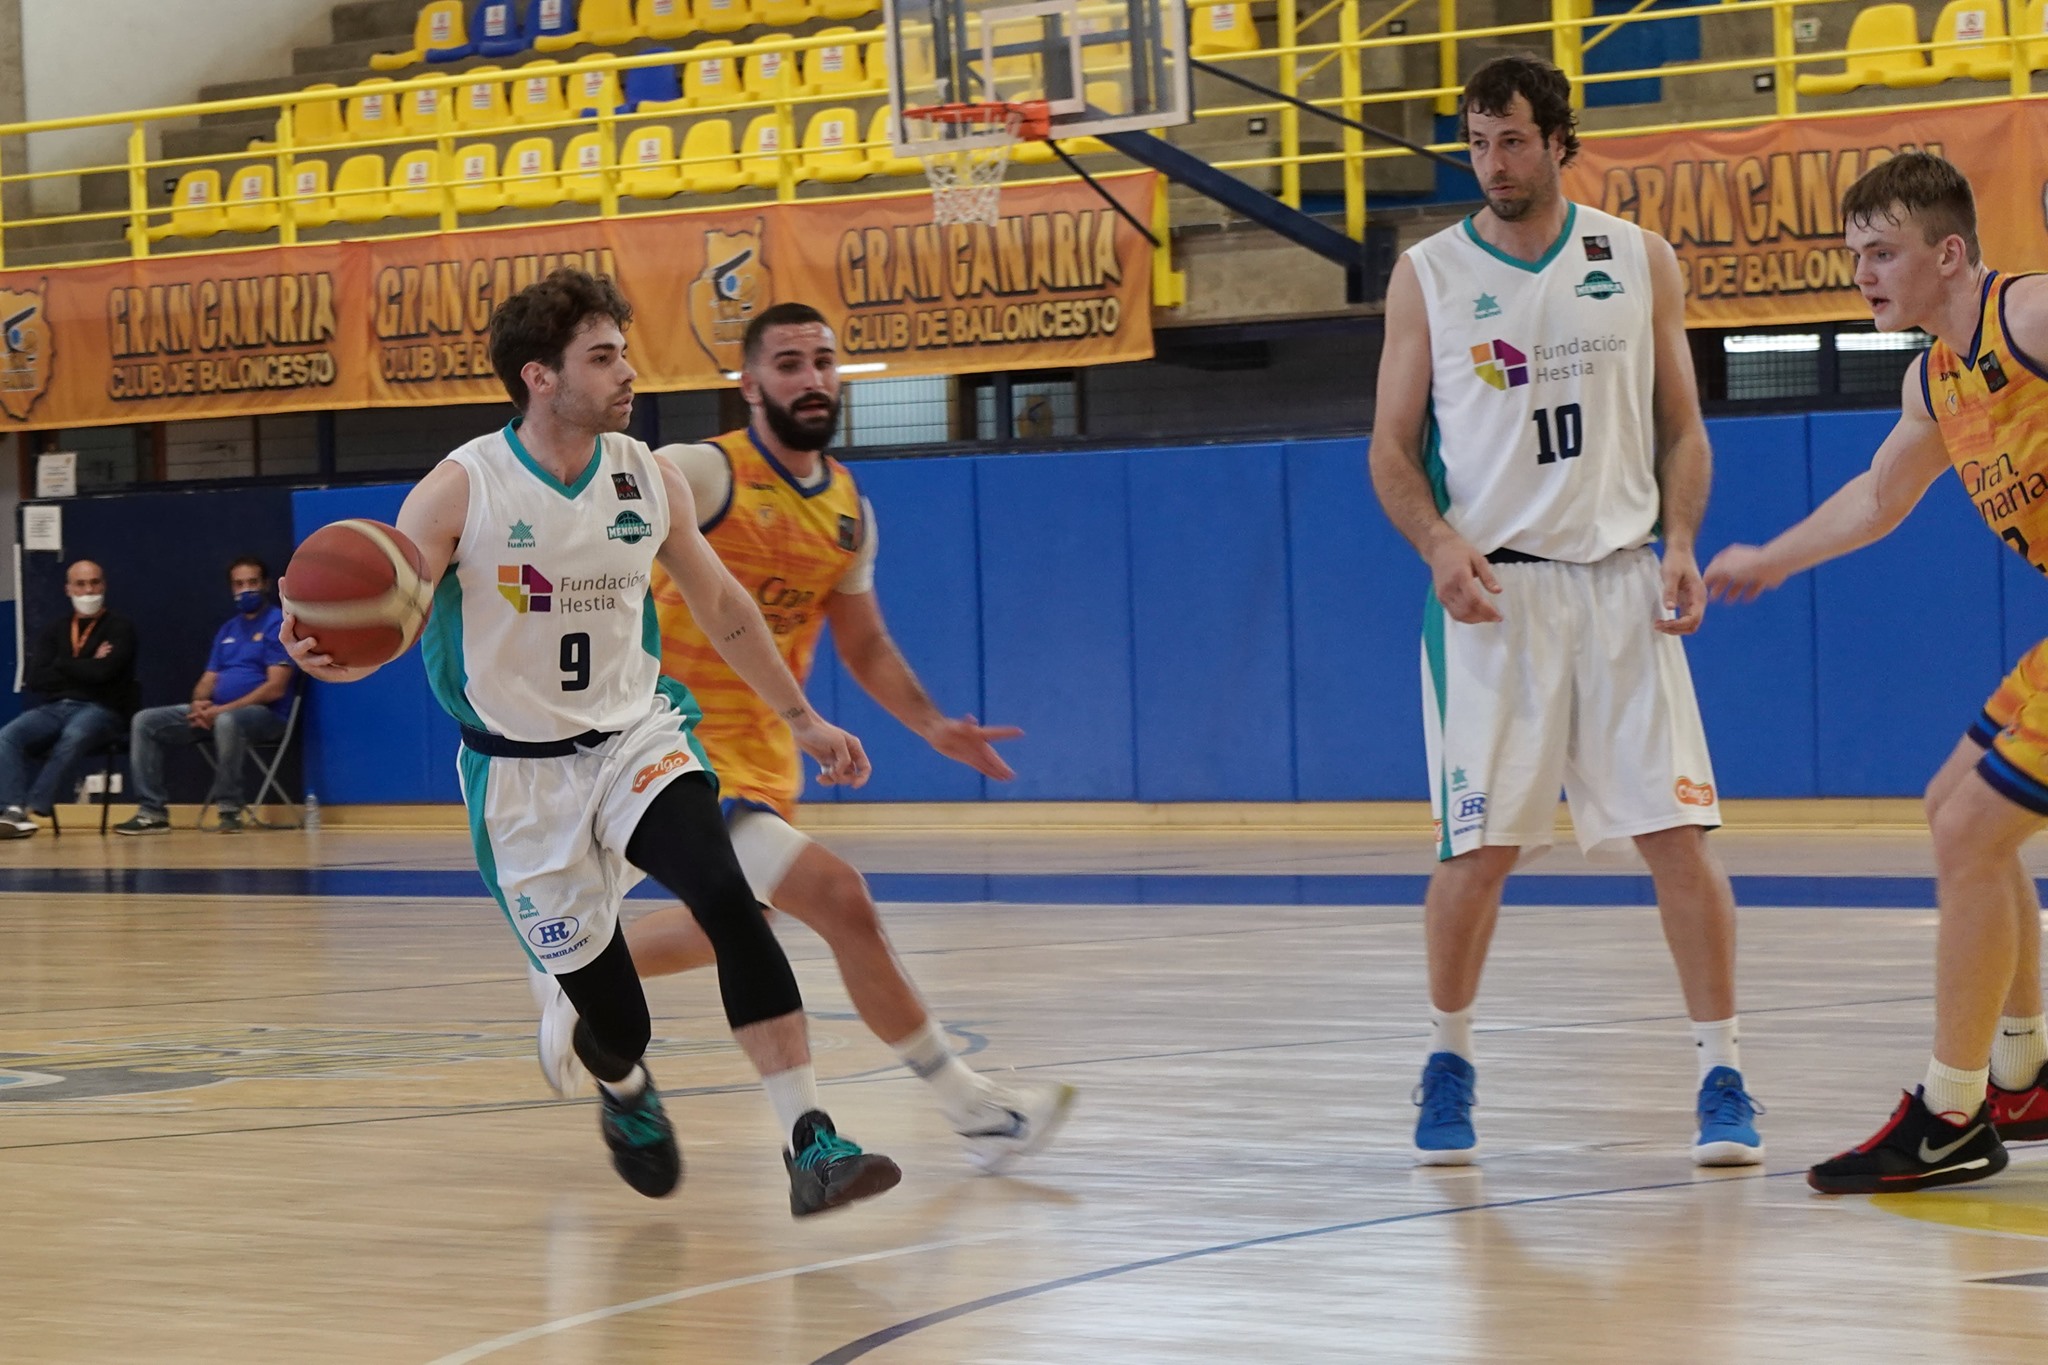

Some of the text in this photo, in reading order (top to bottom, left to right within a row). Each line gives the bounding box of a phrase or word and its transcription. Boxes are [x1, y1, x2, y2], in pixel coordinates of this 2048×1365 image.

[1603, 160, 1734, 247] GRAN
[837, 208, 1122, 310] GRAN CANARIA
[1698, 254, 1738, 299] DE
[109, 271, 337, 360] GRAN CANARIA
[377, 259, 463, 341] GRAN
[843, 296, 1122, 357] CLUB DE BALONCESTO
[1534, 335, 1627, 361] Fundación
[108, 351, 337, 402] CLUB DE BALONCESTO
[382, 344, 437, 384] CLUB
[441, 341, 468, 381] DE
[1536, 361, 1595, 384] Hestia
[1532, 403, 1583, 464] 10
[1979, 472, 2048, 526] naria
[608, 525, 651, 539] MENORCA
[560, 595, 616, 614] Hestia
[560, 632, 590, 691] 9
[538, 921, 570, 944] HR
